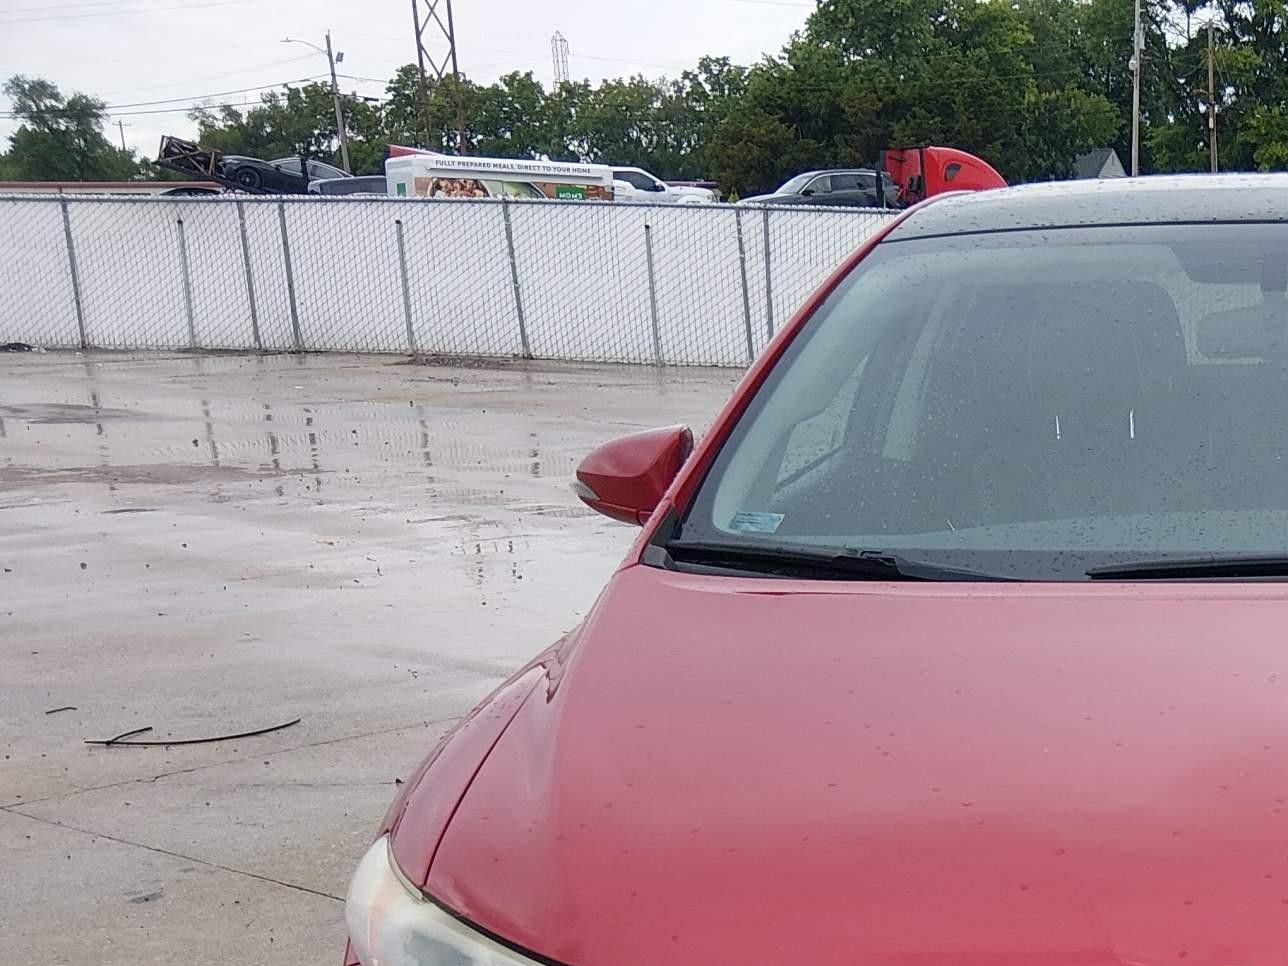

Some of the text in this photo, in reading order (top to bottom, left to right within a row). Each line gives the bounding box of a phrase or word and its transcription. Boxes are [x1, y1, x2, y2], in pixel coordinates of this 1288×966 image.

[435, 159, 456, 167] FULLY
[457, 160, 491, 169] PREPARED
[517, 163, 540, 172] DIRECT
[552, 165, 571, 173] YOUR
